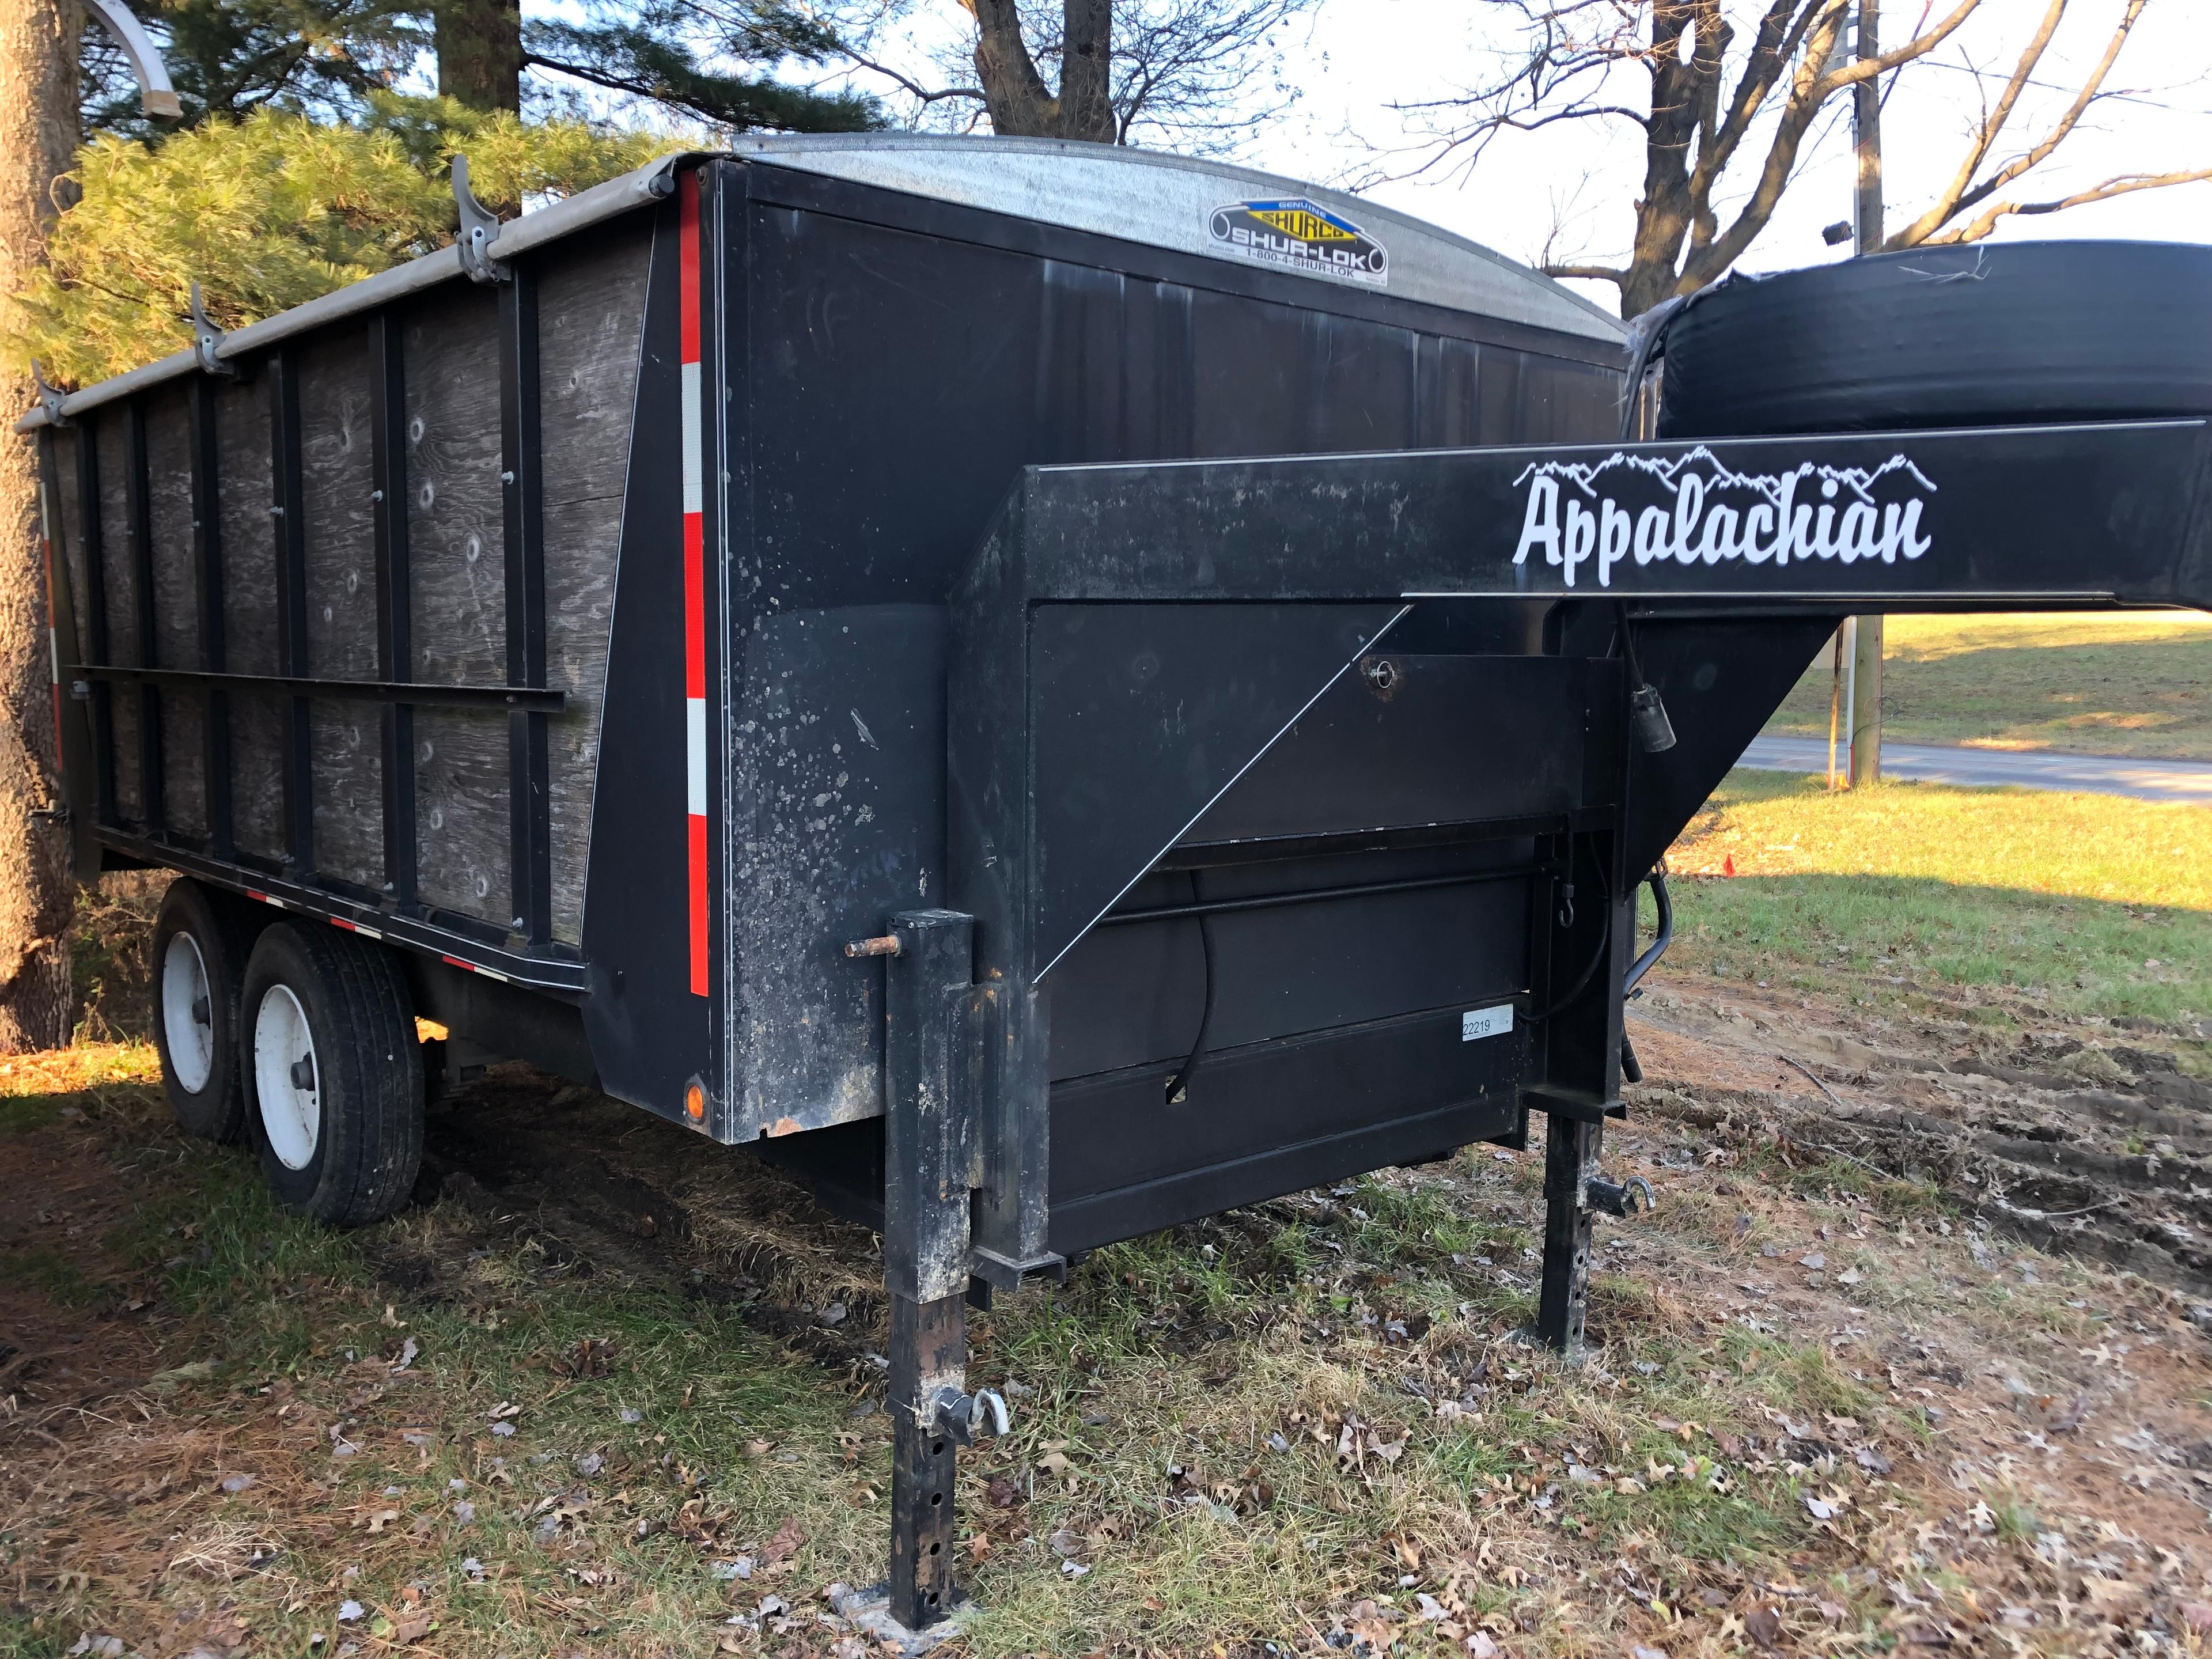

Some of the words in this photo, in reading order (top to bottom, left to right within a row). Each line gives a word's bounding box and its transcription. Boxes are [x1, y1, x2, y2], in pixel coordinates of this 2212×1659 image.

[1262, 211, 1344, 238] SHURCO
[1278, 202, 1327, 219] GENUINE
[1232, 226, 1366, 270] SHUR-LOK
[1246, 247, 1355, 278] 1-800-4-SHUR-LOK
[1512, 471, 1932, 588] Appalachian
[1463, 1019, 1490, 1036] 22219
